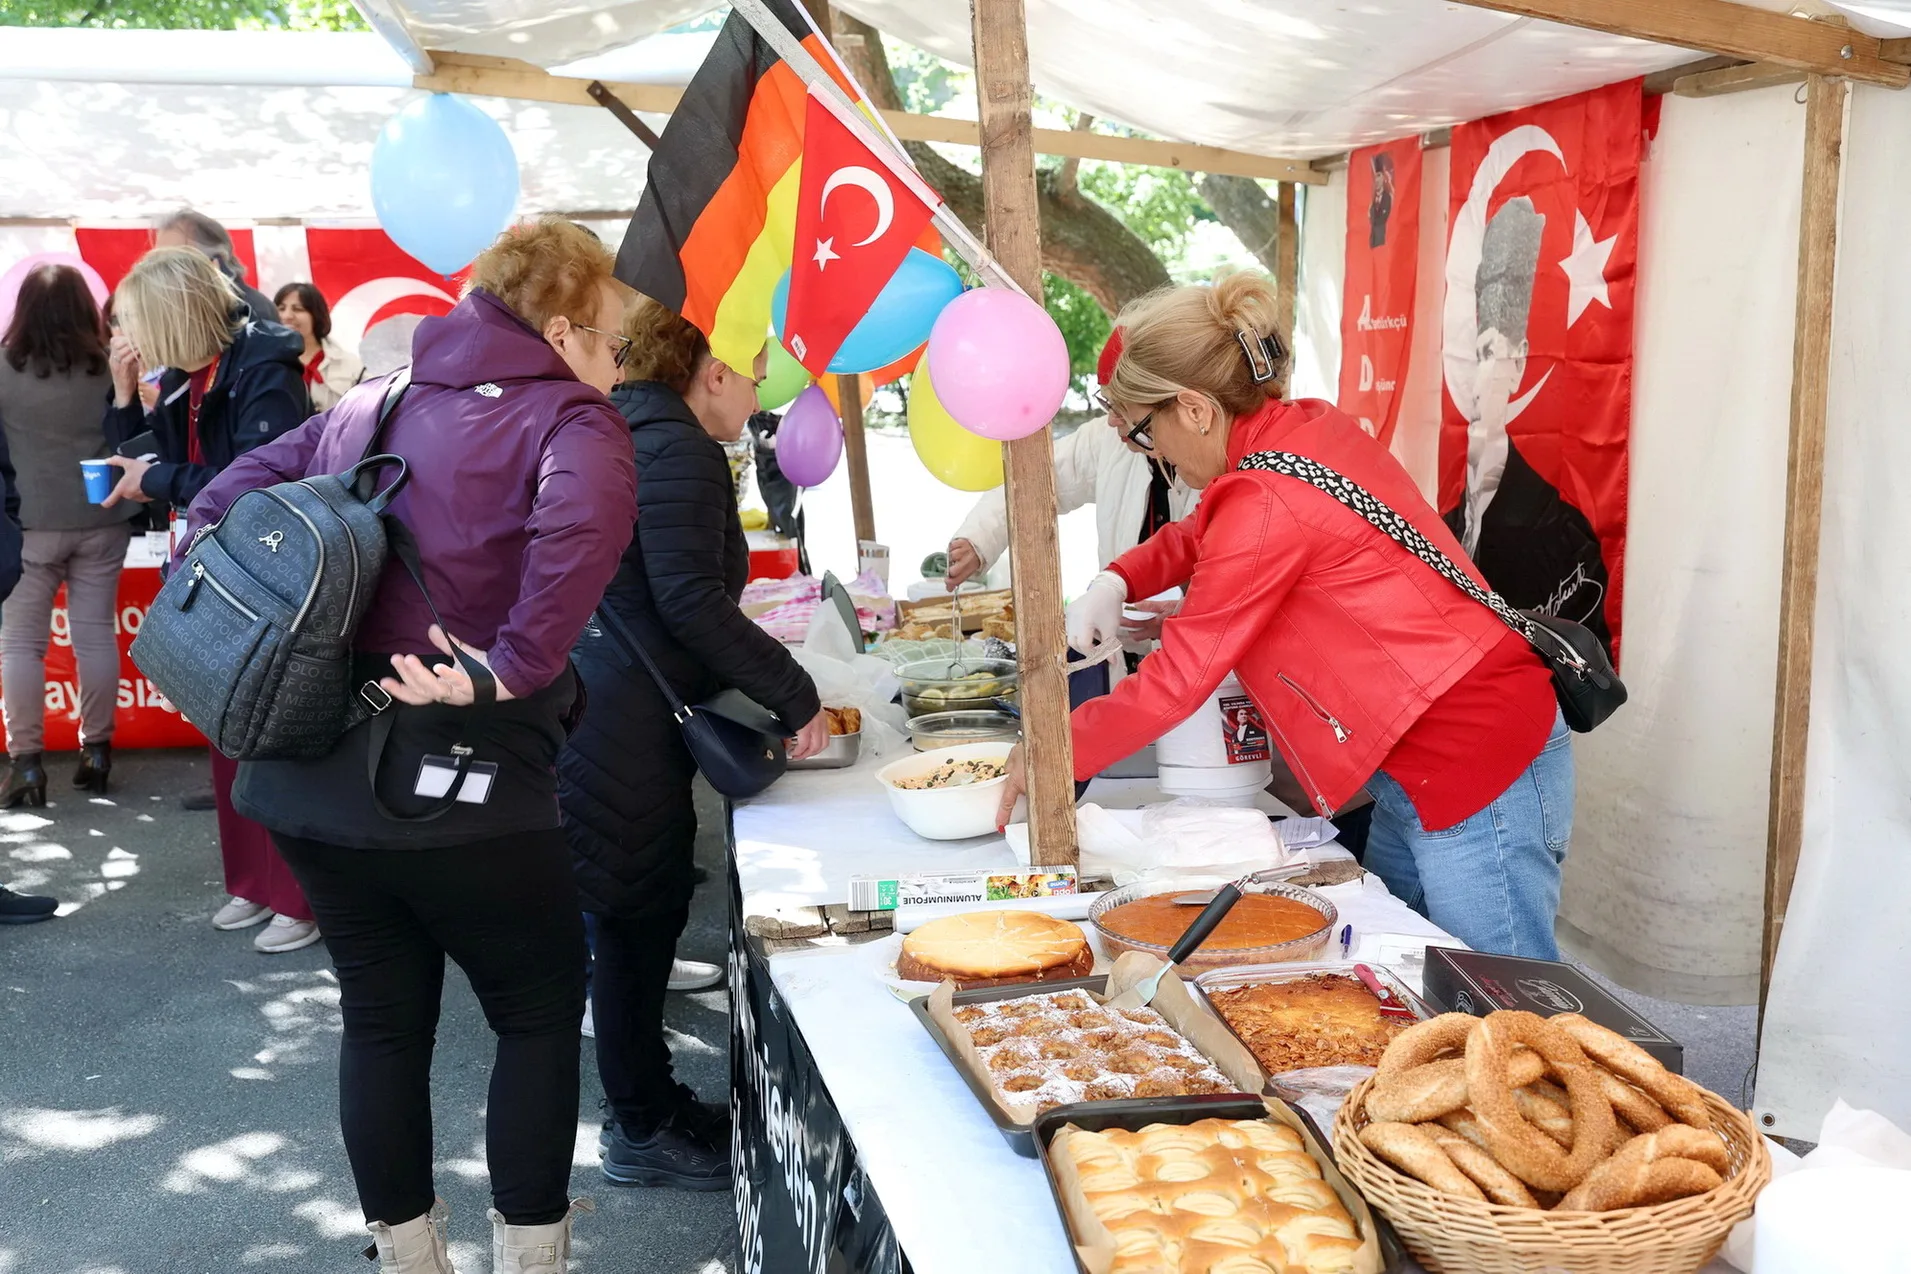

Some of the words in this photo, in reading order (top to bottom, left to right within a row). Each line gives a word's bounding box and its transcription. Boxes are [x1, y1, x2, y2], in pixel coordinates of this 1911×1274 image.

[240, 533, 271, 561] MEGA
[270, 558, 301, 583] POLO
[191, 620, 213, 643] CLUB
[213, 619, 242, 645] POLO
[169, 620, 194, 649] MEGA
[193, 643, 219, 670] POLO
[903, 894, 982, 905] ALUMINIUMFOLIE
